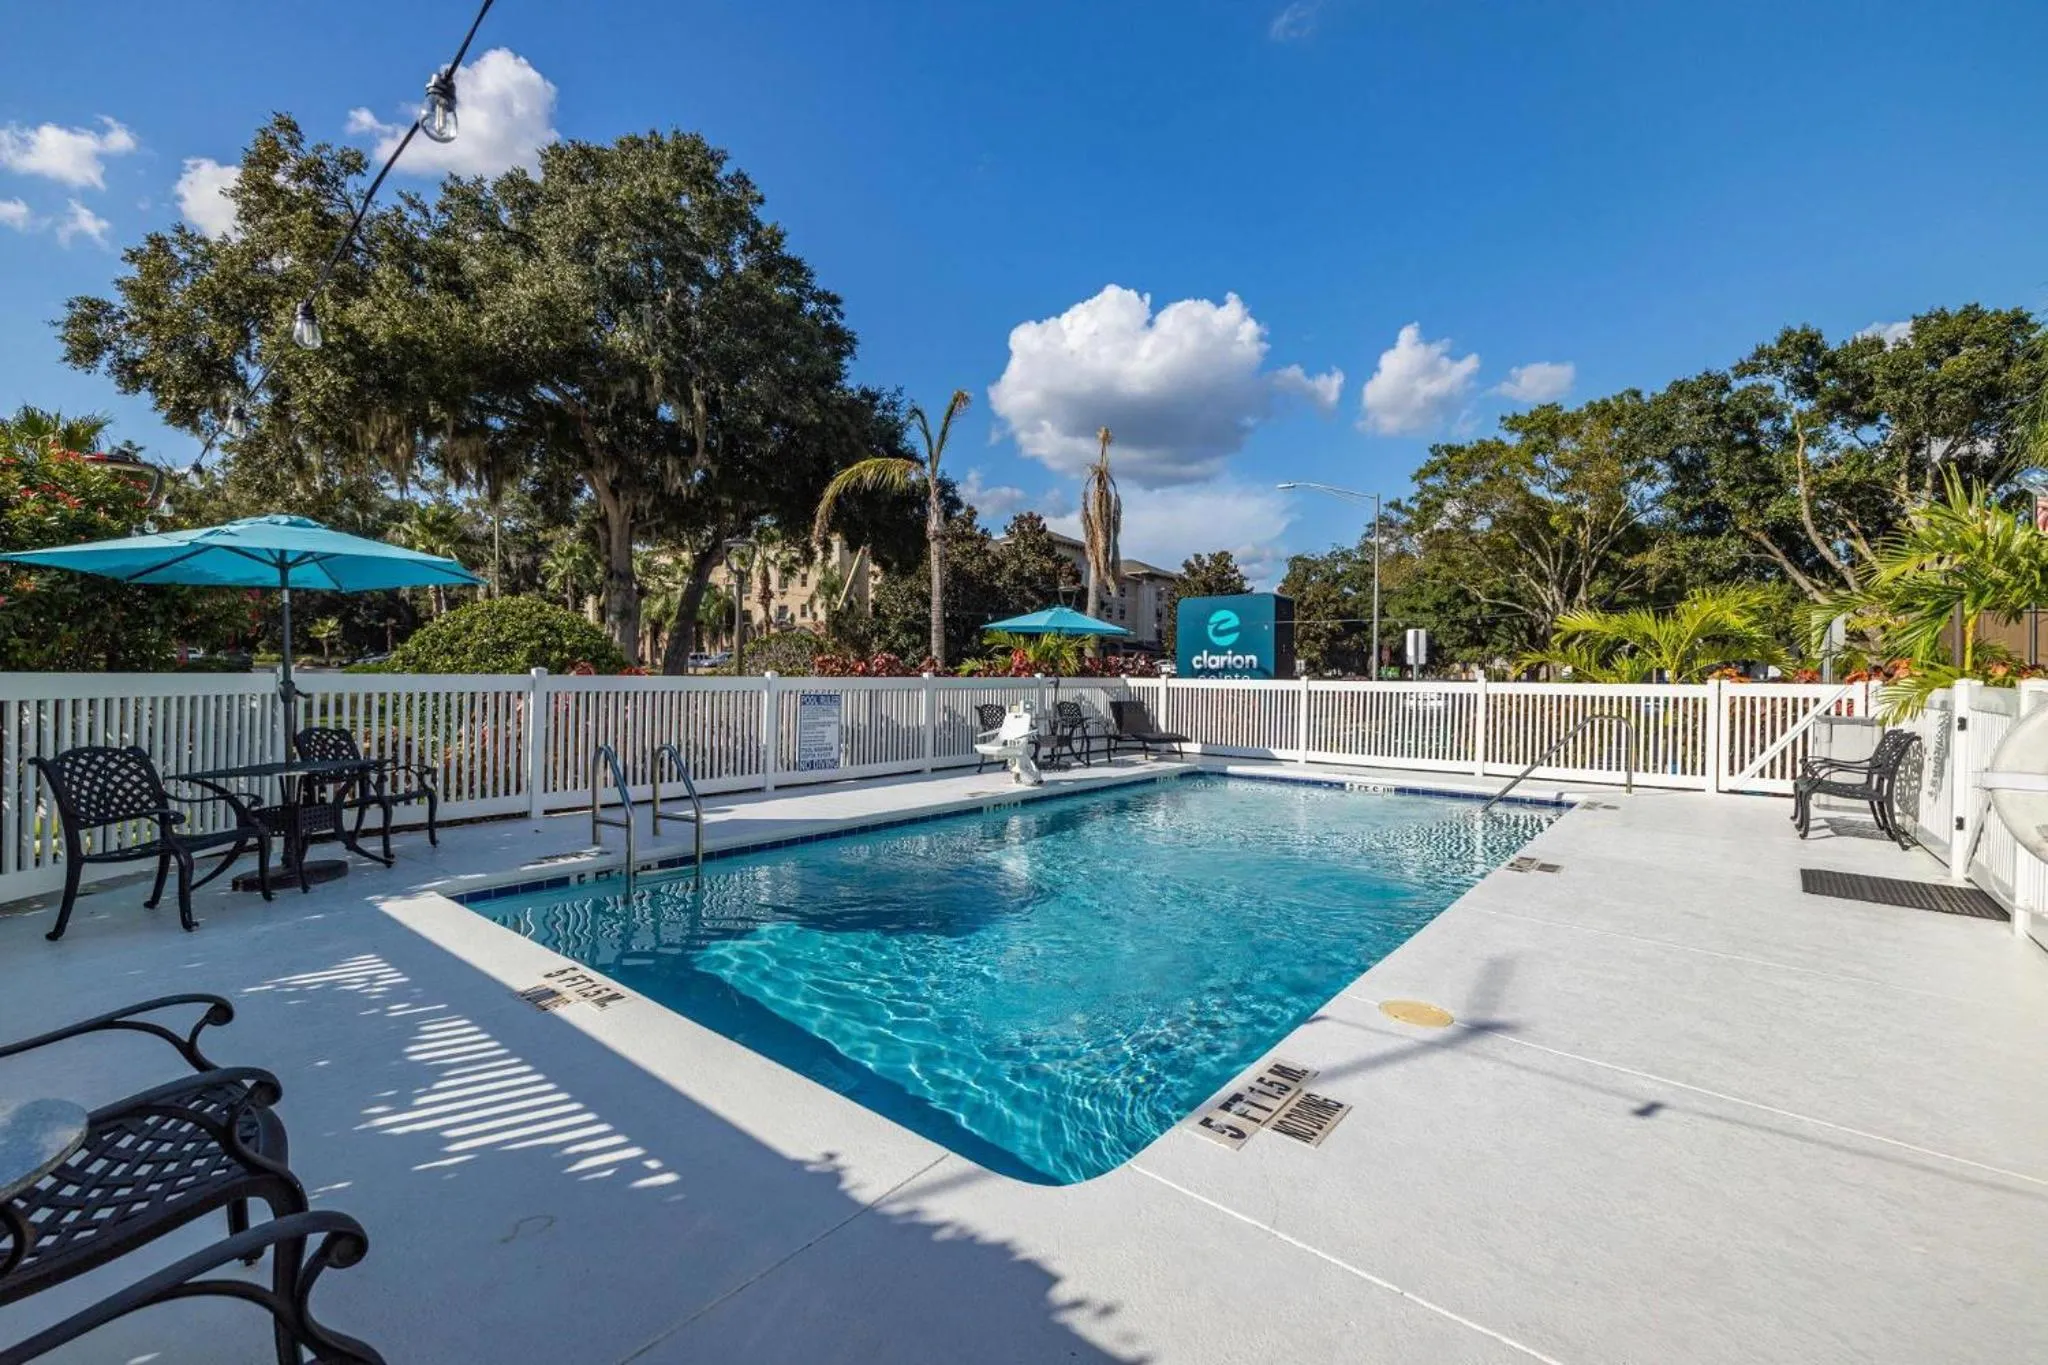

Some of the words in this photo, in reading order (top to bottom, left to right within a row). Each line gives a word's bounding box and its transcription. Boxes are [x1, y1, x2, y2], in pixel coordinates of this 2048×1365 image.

[1191, 649, 1258, 669] clarion
[800, 759, 811, 771] NO
[1248, 1076, 1293, 1101] 1.5
[1218, 1092, 1273, 1124] FT
[1283, 1092, 1344, 1131] DIVING
[1198, 1116, 1248, 1140] 5
[1270, 1119, 1318, 1144] NO
